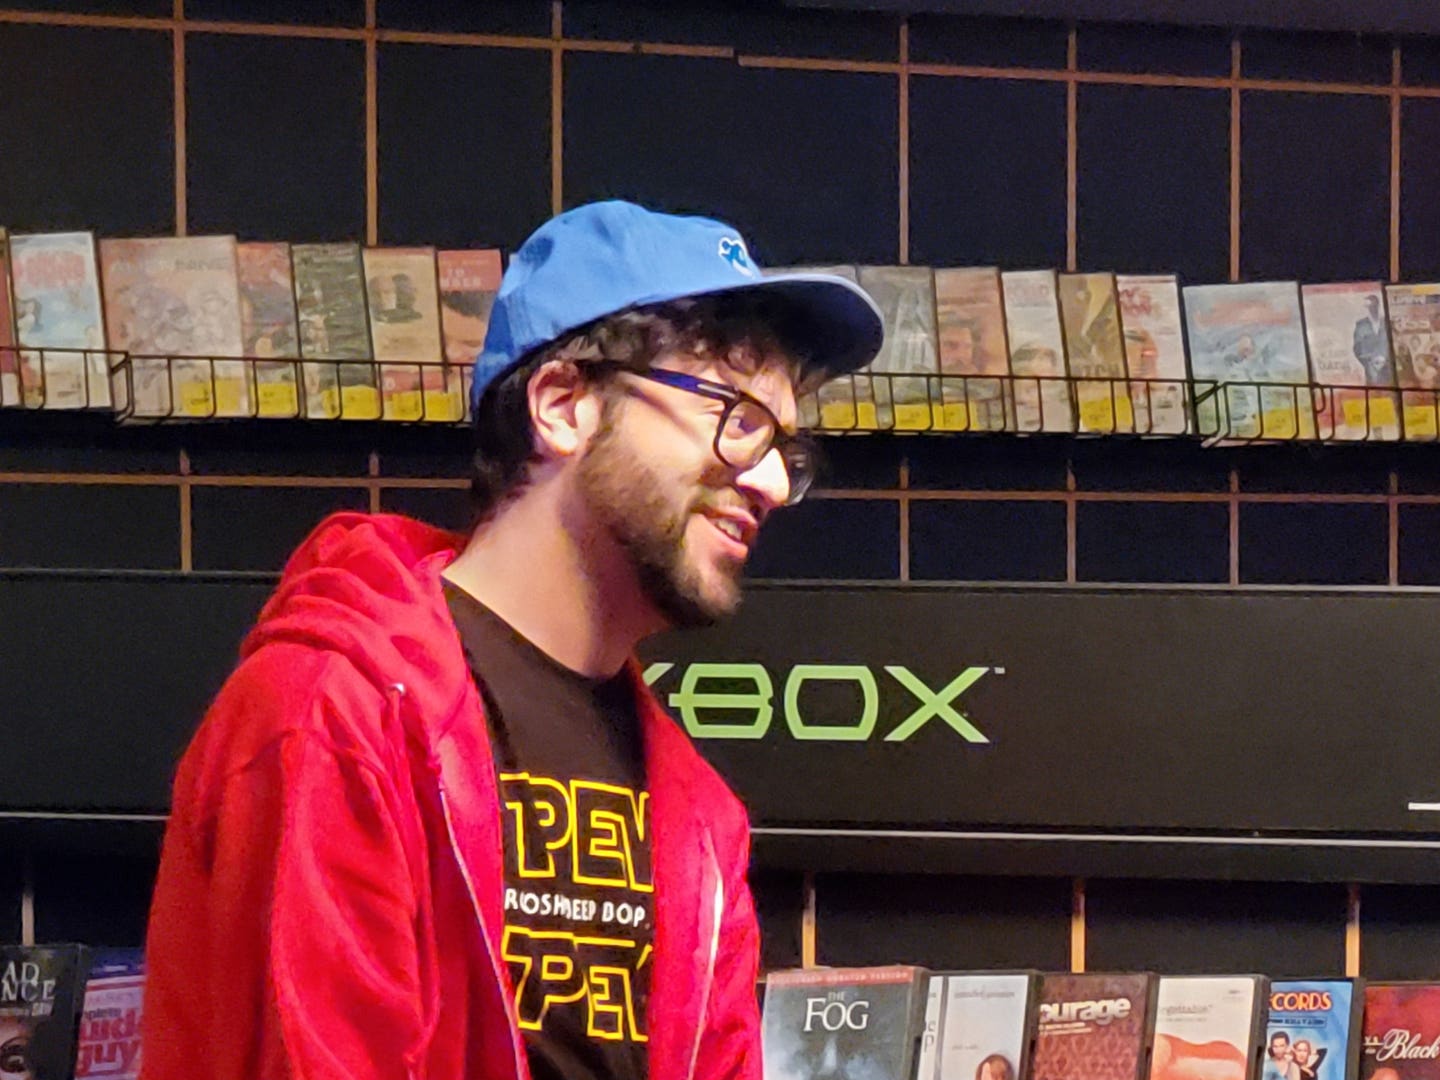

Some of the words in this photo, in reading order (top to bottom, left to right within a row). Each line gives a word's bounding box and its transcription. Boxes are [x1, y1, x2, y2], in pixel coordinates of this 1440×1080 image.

[645, 663, 991, 744] BOX
[827, 990, 846, 1000] THE
[1268, 991, 1332, 1012] CORDS
[803, 997, 870, 1032] FOG
[75, 1039, 142, 1077] guy
